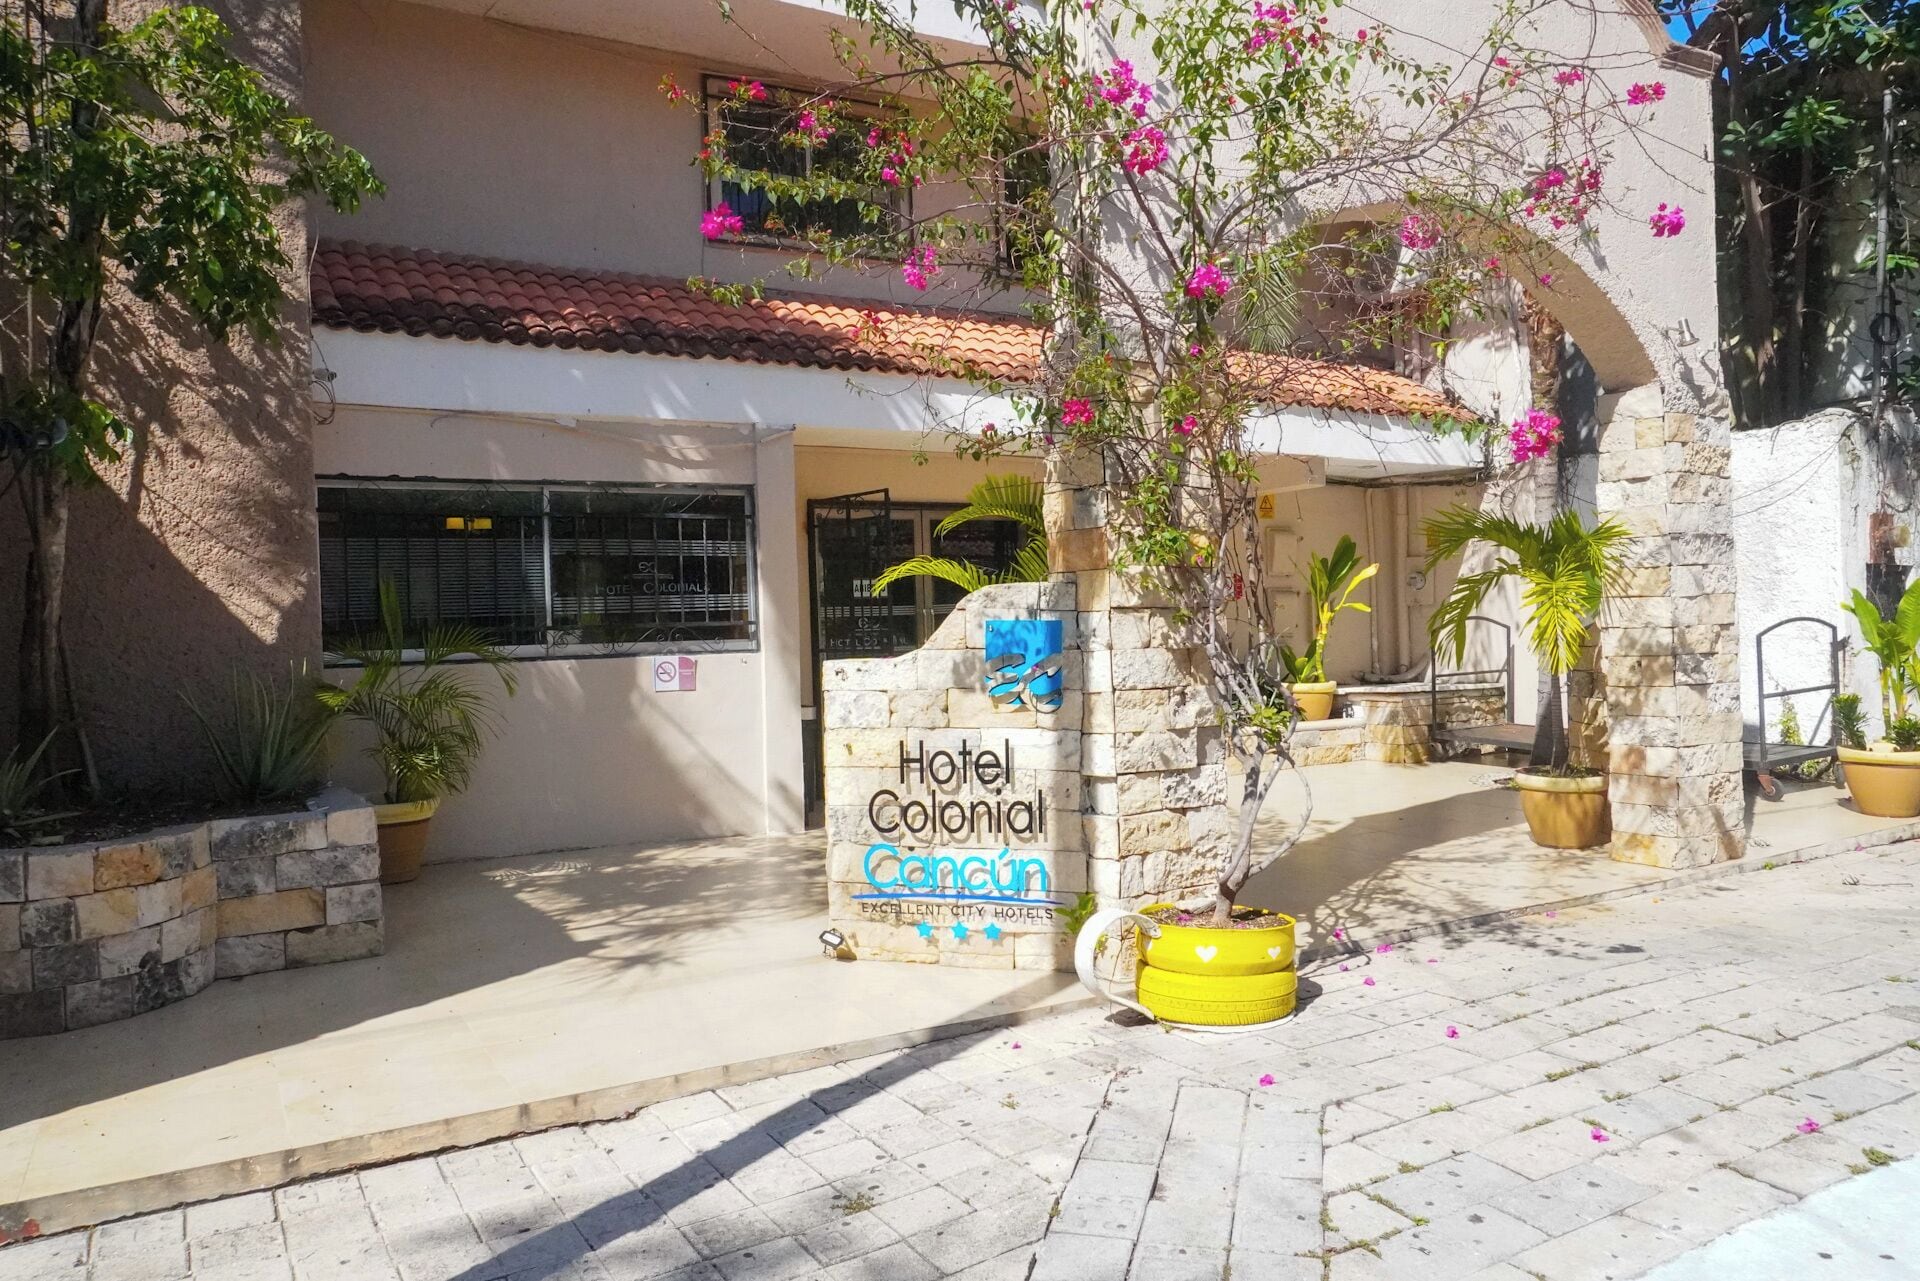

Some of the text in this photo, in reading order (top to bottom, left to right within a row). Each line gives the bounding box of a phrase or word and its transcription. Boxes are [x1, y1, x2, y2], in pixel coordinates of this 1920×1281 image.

[899, 738, 1010, 785] Hotel
[868, 788, 1044, 834] Colonial
[863, 843, 1048, 892] Cancún
[861, 902, 1054, 920] EXCELLENT CITY HOTELS
